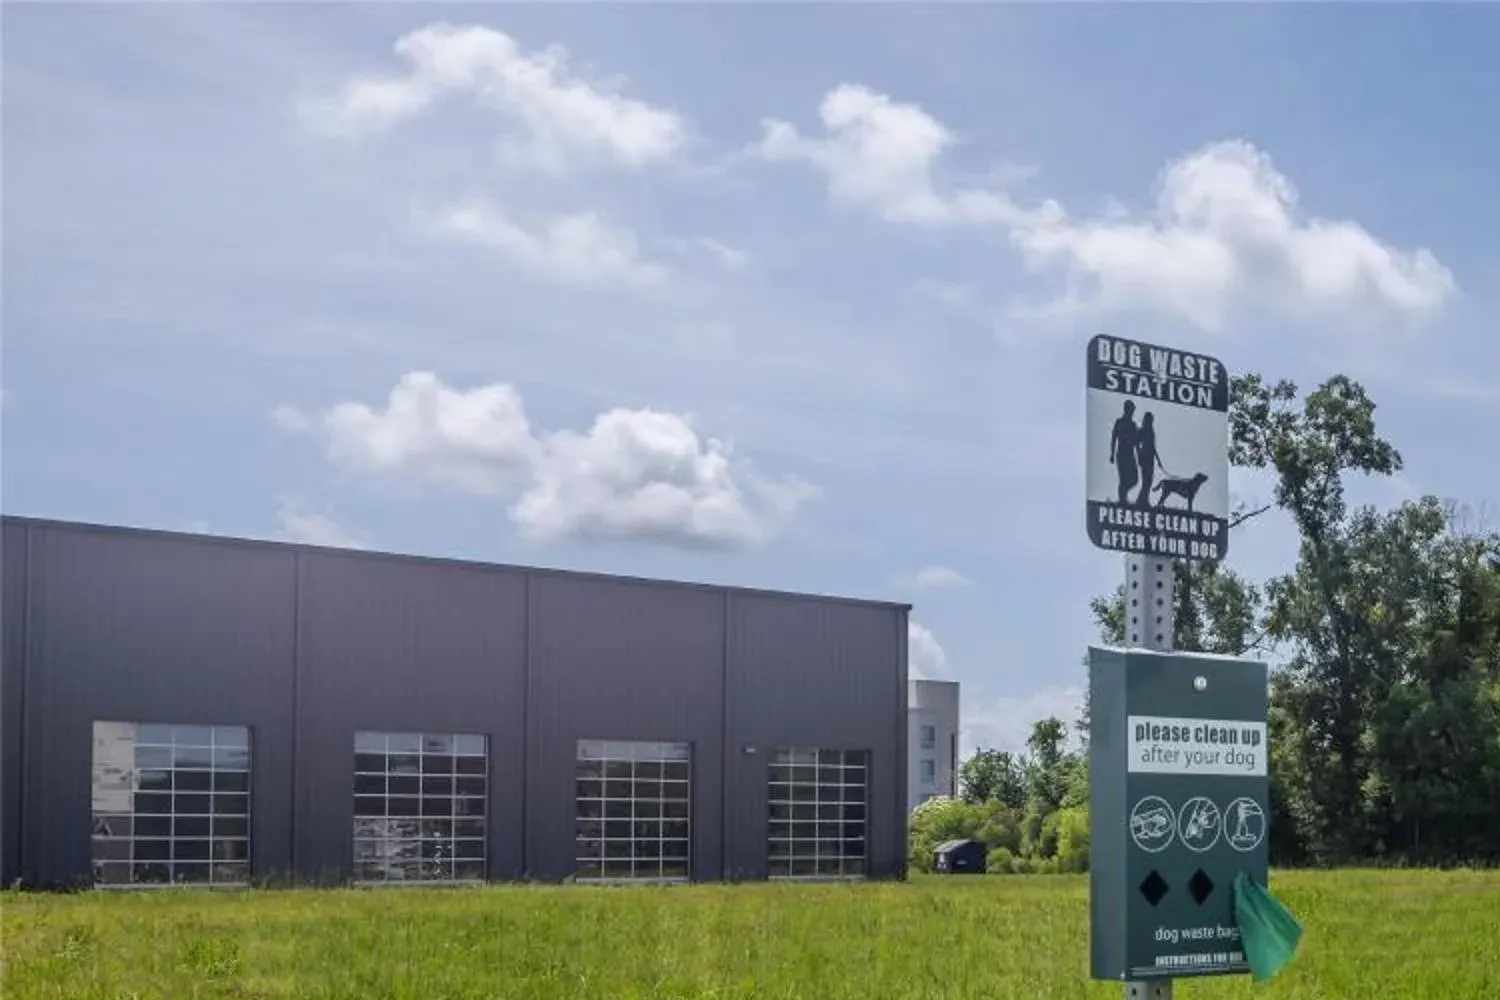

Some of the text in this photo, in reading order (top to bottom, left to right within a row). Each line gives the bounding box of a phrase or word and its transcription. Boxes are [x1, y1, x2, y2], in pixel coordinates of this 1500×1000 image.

[1099, 339, 1219, 383] DOG WASTE
[1106, 370, 1213, 407] STATION
[1099, 507, 1219, 537] PLEASE CLEAN UP
[1101, 530, 1217, 559] AFTER YOUR DOG
[1135, 722, 1261, 747] please clean up
[1141, 744, 1255, 770] after your dog
[1155, 927, 1179, 944] dog
[1181, 926, 1214, 940] waste
